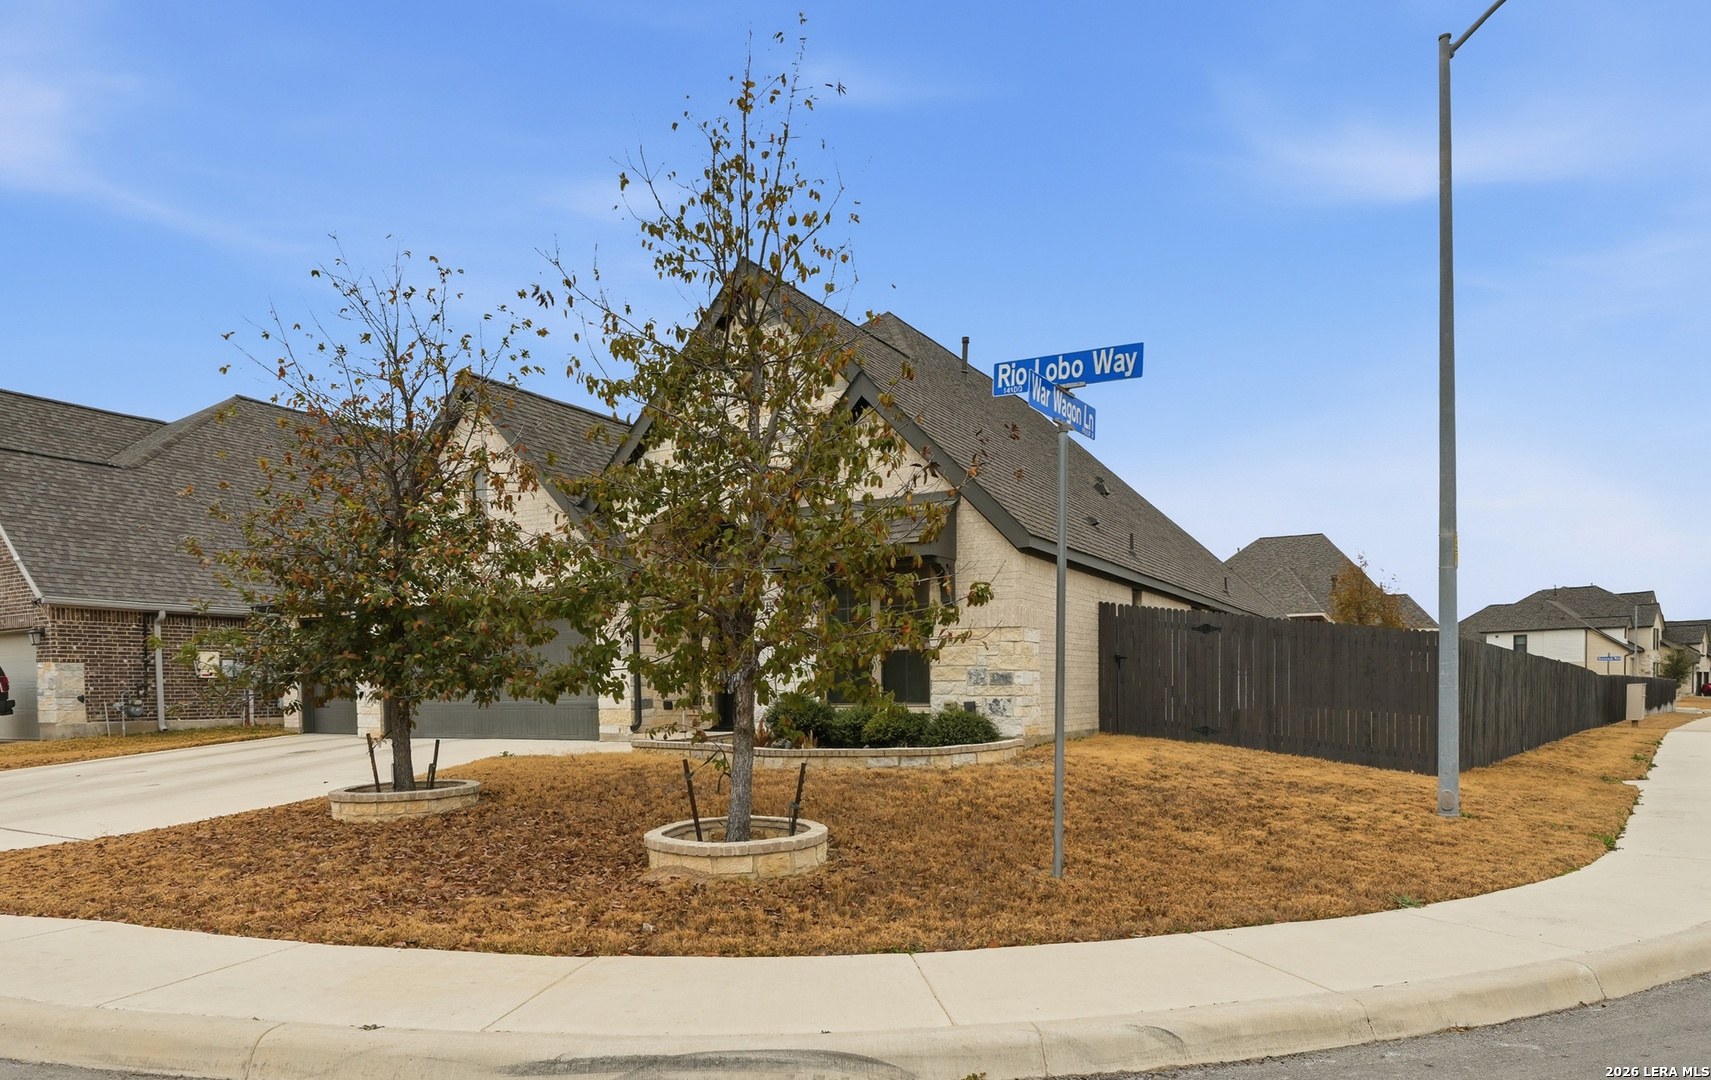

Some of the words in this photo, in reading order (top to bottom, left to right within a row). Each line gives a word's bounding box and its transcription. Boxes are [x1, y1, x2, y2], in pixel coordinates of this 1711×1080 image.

[998, 363, 1027, 388] Rio
[1092, 348, 1138, 377] Way
[1031, 373, 1050, 407] War
[1053, 386, 1082, 424] Wagon
[1083, 405, 1094, 432] Ln
